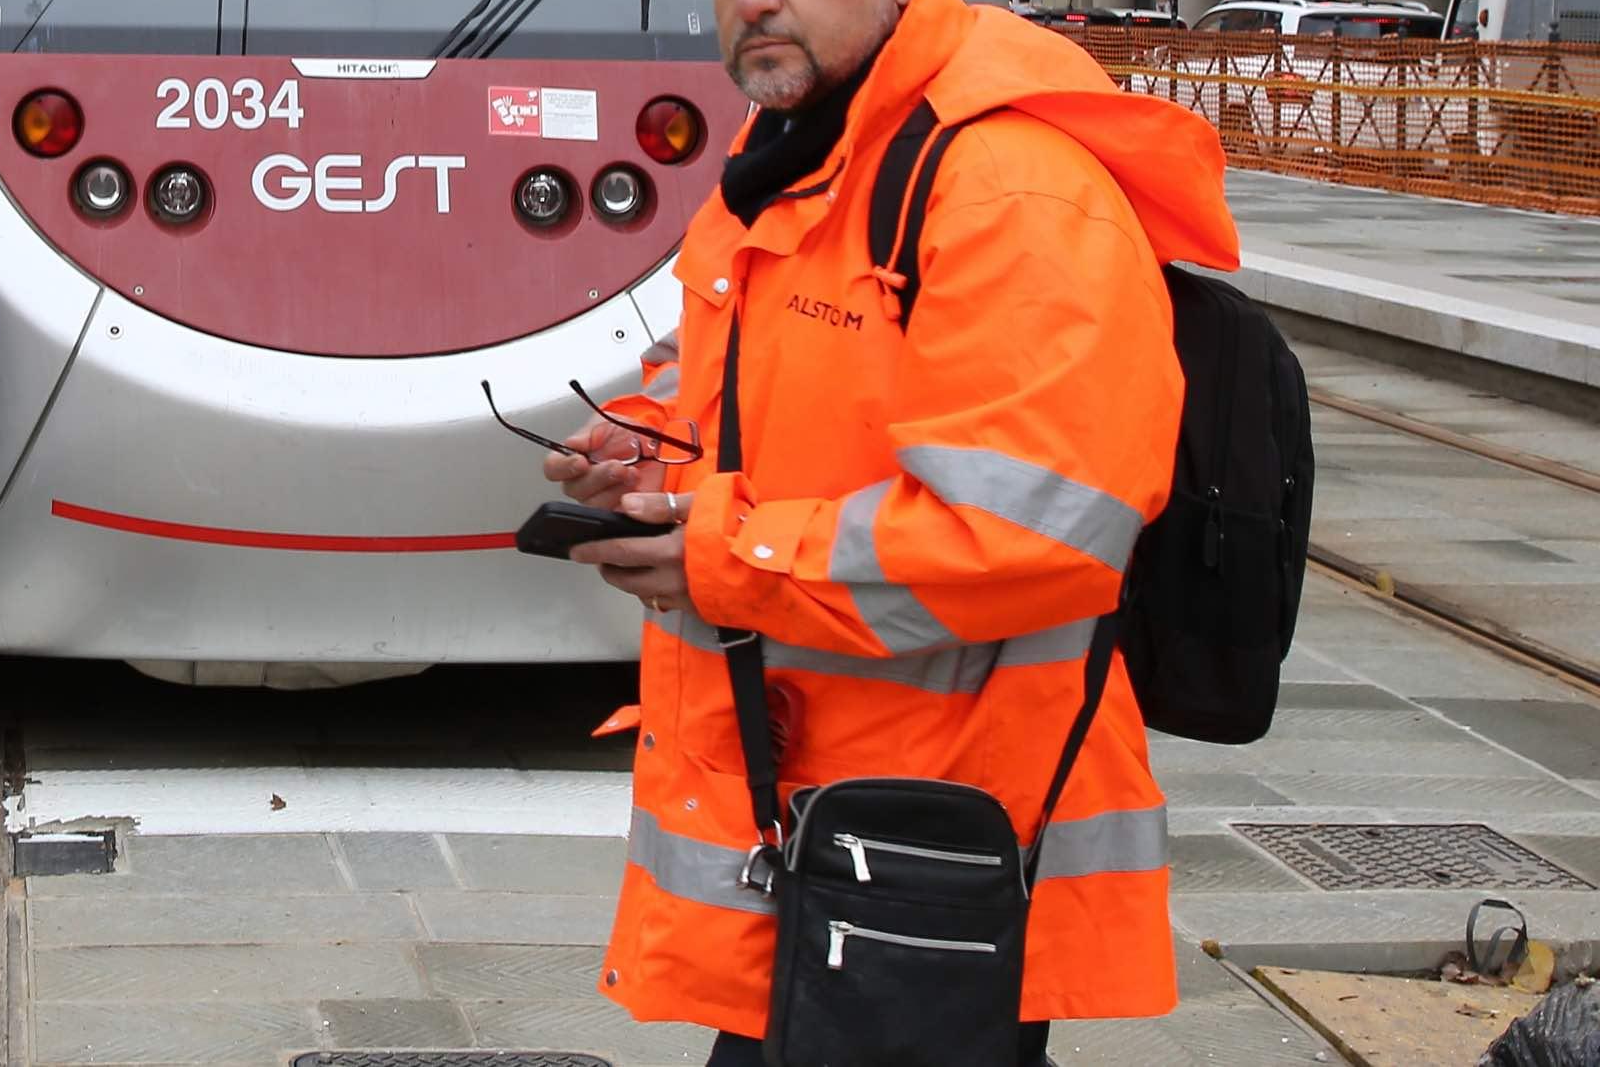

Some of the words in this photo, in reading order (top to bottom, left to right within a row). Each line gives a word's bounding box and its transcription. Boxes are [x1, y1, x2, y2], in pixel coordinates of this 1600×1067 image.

[336, 63, 392, 74] HITACHI
[156, 79, 304, 129] 2034
[252, 153, 466, 213] GEST
[786, 294, 864, 331] ALSTOM
